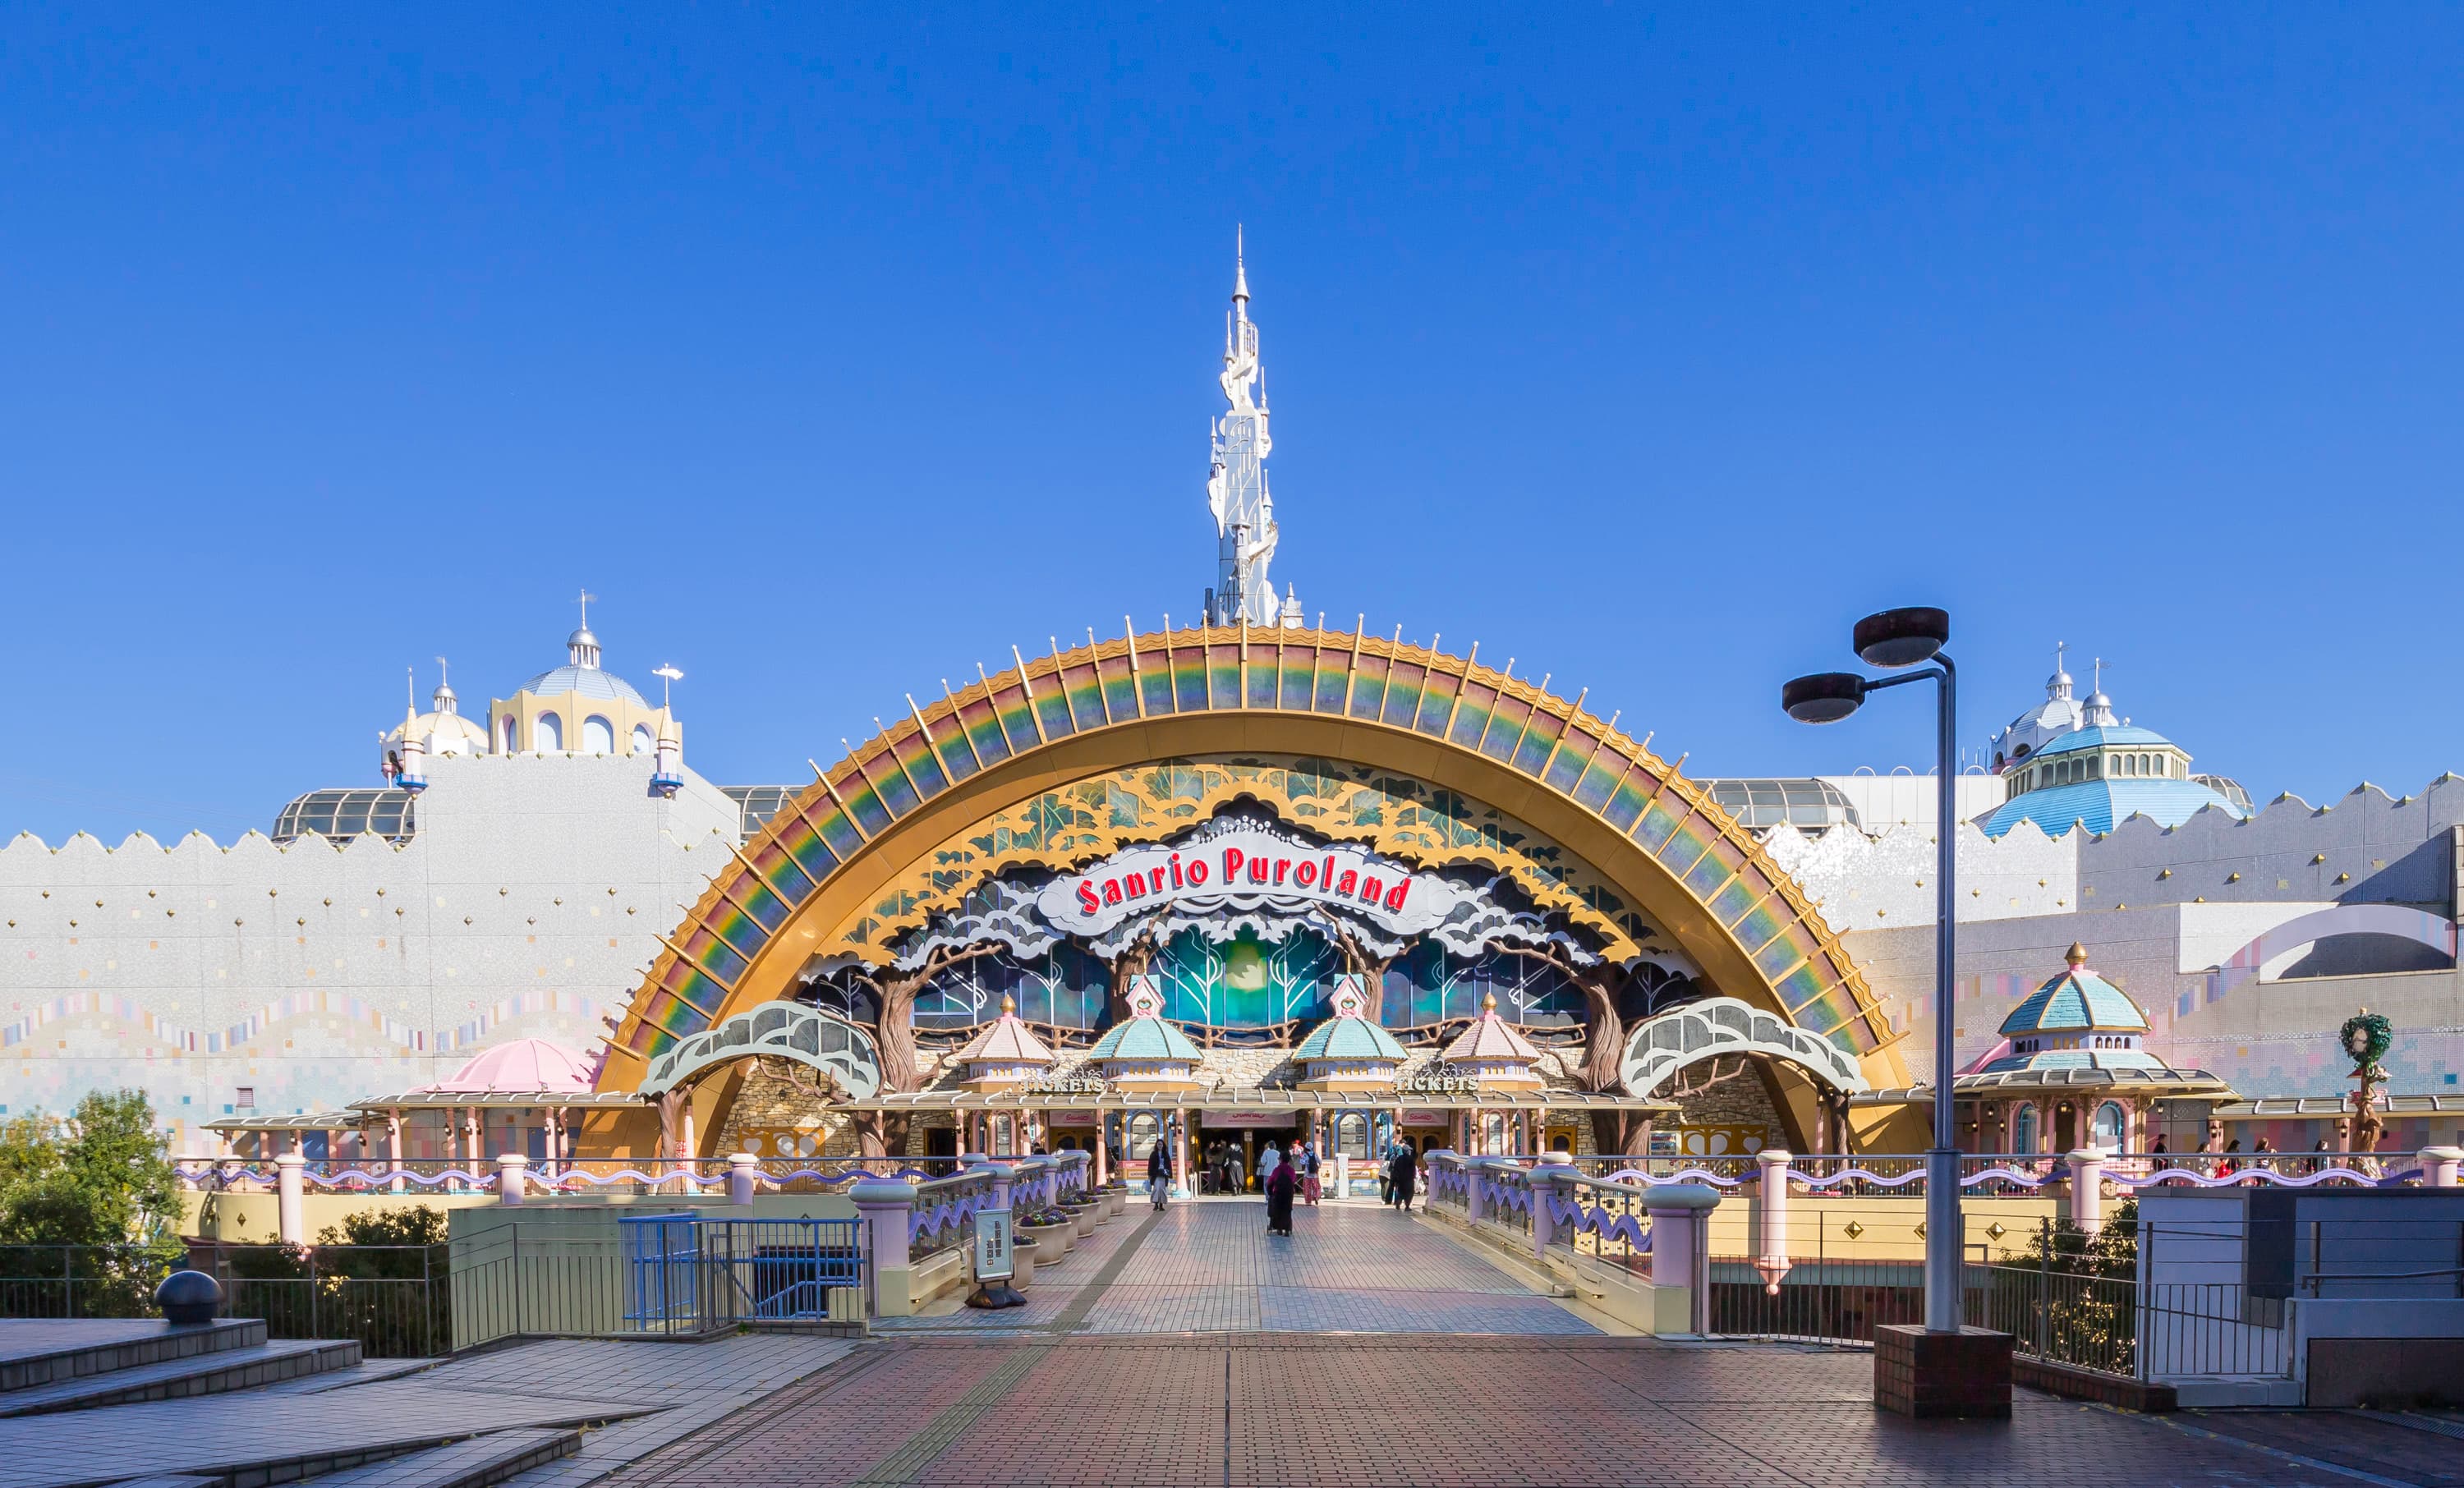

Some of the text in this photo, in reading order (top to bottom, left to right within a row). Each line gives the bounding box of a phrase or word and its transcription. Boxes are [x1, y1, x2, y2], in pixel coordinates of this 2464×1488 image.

[1078, 847, 1412, 913] Sanrio Puroland
[1023, 1077, 1104, 1092] TICKETS
[1395, 1076, 1479, 1091] TICKETS
